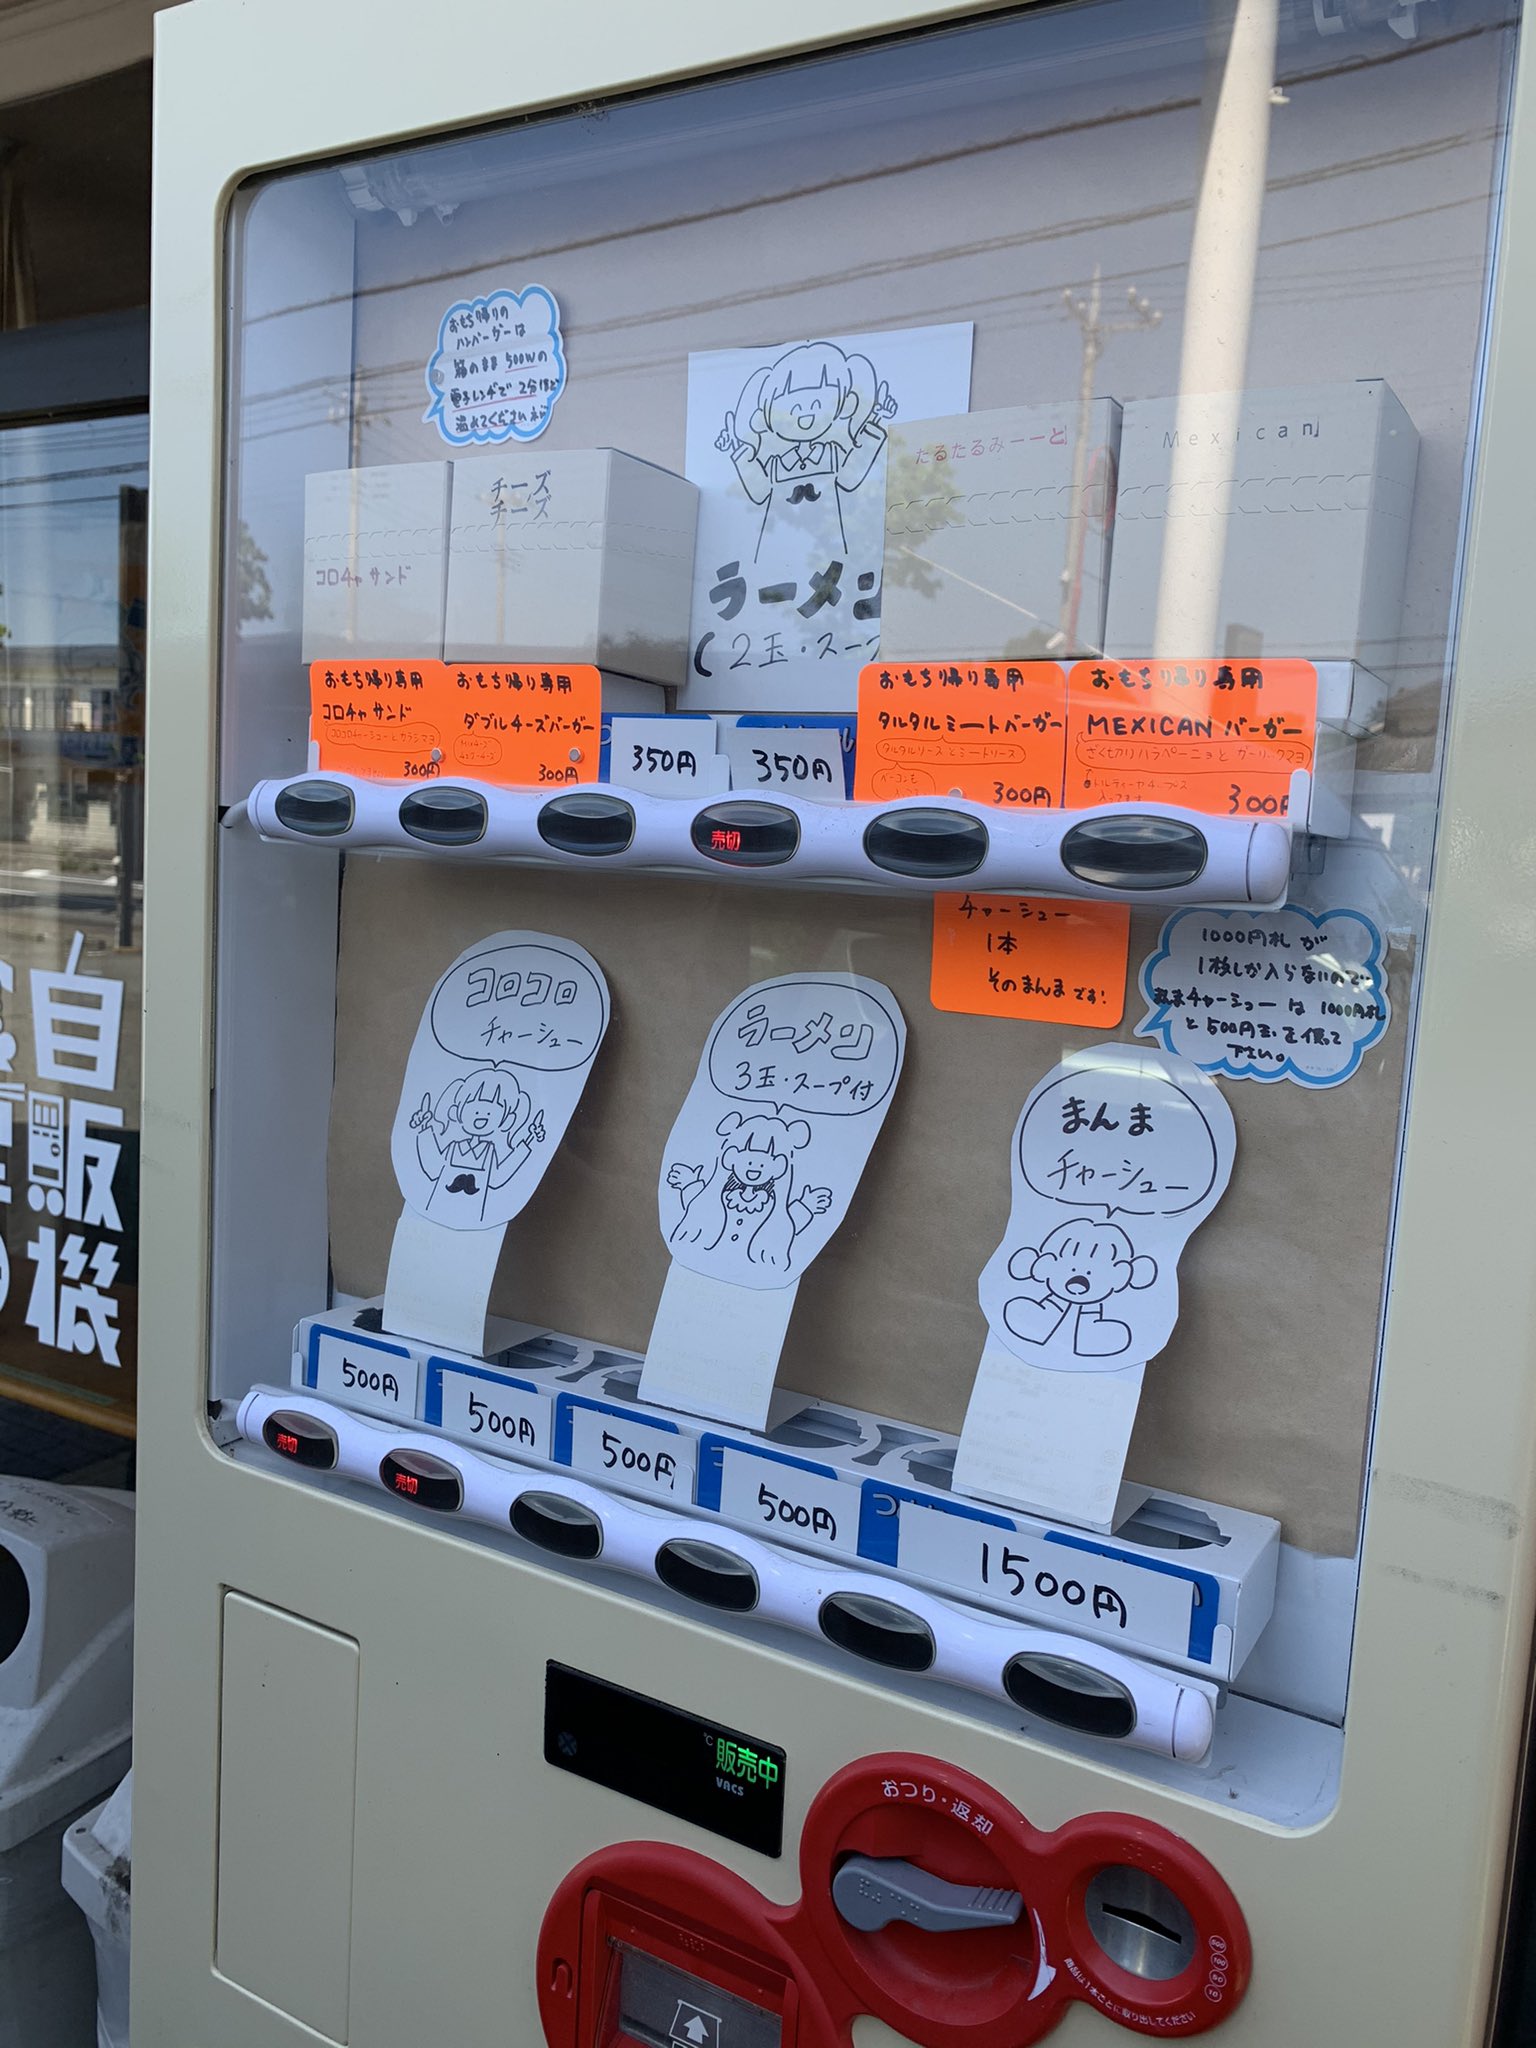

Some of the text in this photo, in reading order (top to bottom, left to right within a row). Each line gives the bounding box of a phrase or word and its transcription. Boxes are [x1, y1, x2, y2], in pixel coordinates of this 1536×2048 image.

[491, 469, 551, 502] チーズ
[489, 494, 552, 531] チーズ
[324, 670, 424, 690] おもち帰り専用
[456, 671, 572, 694] おもち帰り専用
[879, 667, 1024, 692] おもち帰り専用
[463, 711, 596, 733] ダブルチーズバーガー
[878, 711, 1063, 734] タルタルミートバーガー
[1087, 713, 1303, 739] MEXICAN バーガー
[403, 761, 440, 778] 300円
[538, 764, 579, 784] 300円
[632, 744, 697, 777] 350円
[751, 749, 832, 784] 350円
[992, 781, 1052, 808] 300円
[711, 830, 742, 852] 売切
[958, 894, 1071, 922] チャーシュー
[986, 931, 1018, 955] 1本
[466, 967, 578, 1008] コロコロ
[480, 1016, 583, 1048] チャーシュー
[737, 1004, 875, 1061] ラーメン
[734, 1061, 875, 1101] 3玉・スープ付
[1062, 1096, 1155, 1136] まんま
[1047, 1148, 1189, 1194] チャーシュー
[342, 1357, 399, 1402] 500円
[468, 1391, 535, 1447] 500円
[276, 1432, 298, 1455] 売切
[602, 1430, 677, 1491] 500円
[395, 1473, 418, 1496] 売切
[758, 1482, 837, 1541] 500円
[979, 1543, 1128, 1630] 1500円
[715, 1737, 779, 1790] 販売中
[881, 1777, 995, 1838] おつり・返却
